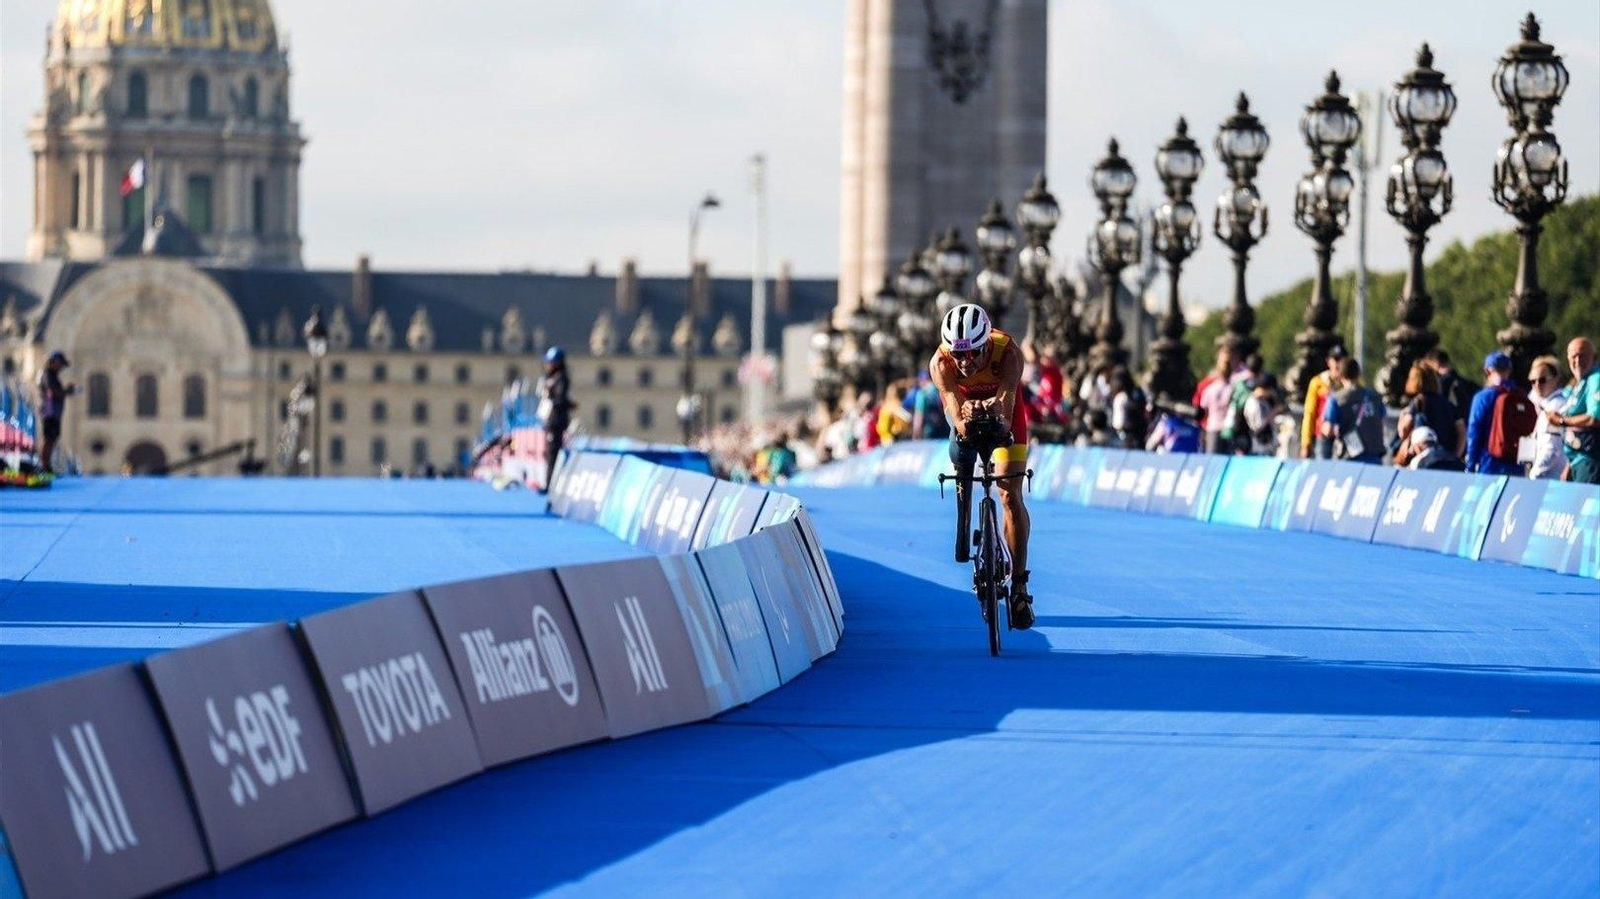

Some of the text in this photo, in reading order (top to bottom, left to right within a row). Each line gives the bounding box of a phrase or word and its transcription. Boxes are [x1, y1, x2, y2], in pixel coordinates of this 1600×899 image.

[460, 627, 550, 704] Allianz
[613, 596, 668, 696] All
[341, 652, 452, 748] TOYOTA
[52, 721, 139, 864] All
